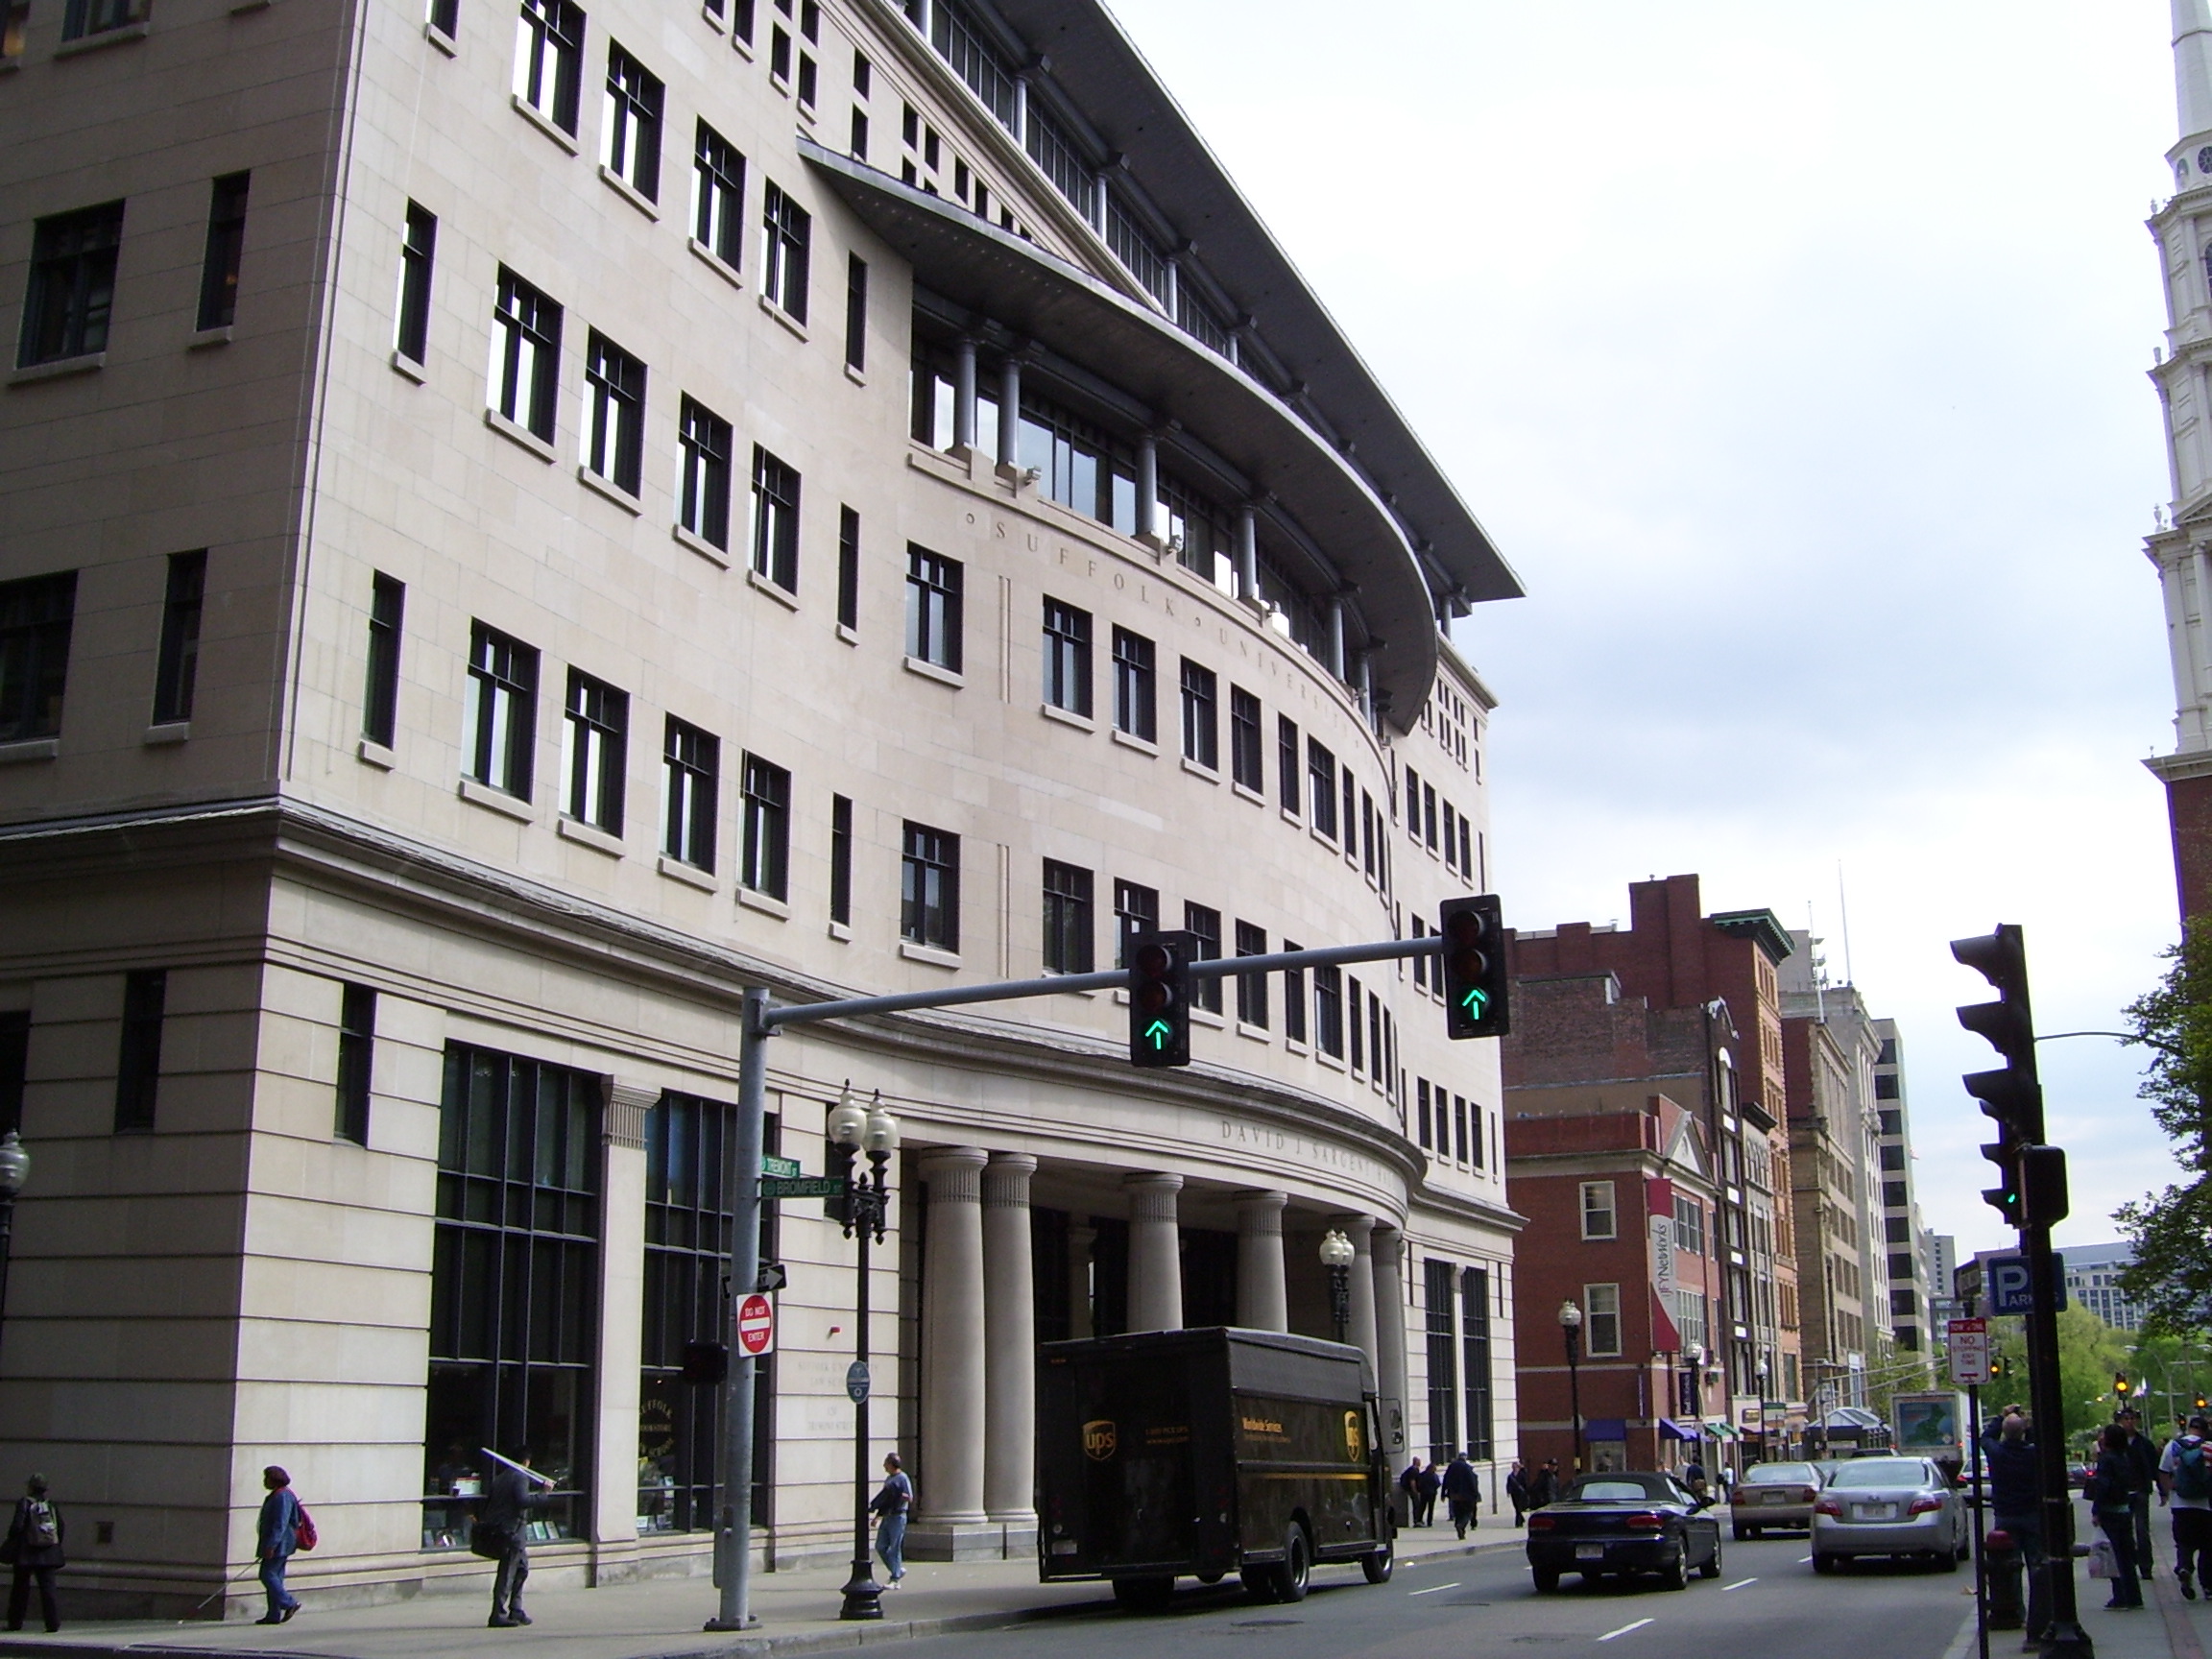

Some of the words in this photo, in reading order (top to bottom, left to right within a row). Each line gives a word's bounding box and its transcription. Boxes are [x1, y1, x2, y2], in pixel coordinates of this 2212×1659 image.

[996, 521, 1174, 617] SUFFOLK
[1221, 1121, 1285, 1150] DAVID
[1312, 1142, 1370, 1176] SARGENT
[776, 1180, 830, 1195] BROMFIELD
[744, 1307, 755, 1317] DO
[755, 1306, 765, 1316] NOT
[747, 1332, 765, 1343] ENTER
[1960, 1335, 1975, 1345] NO
[1086, 1432, 1114, 1455] ups
